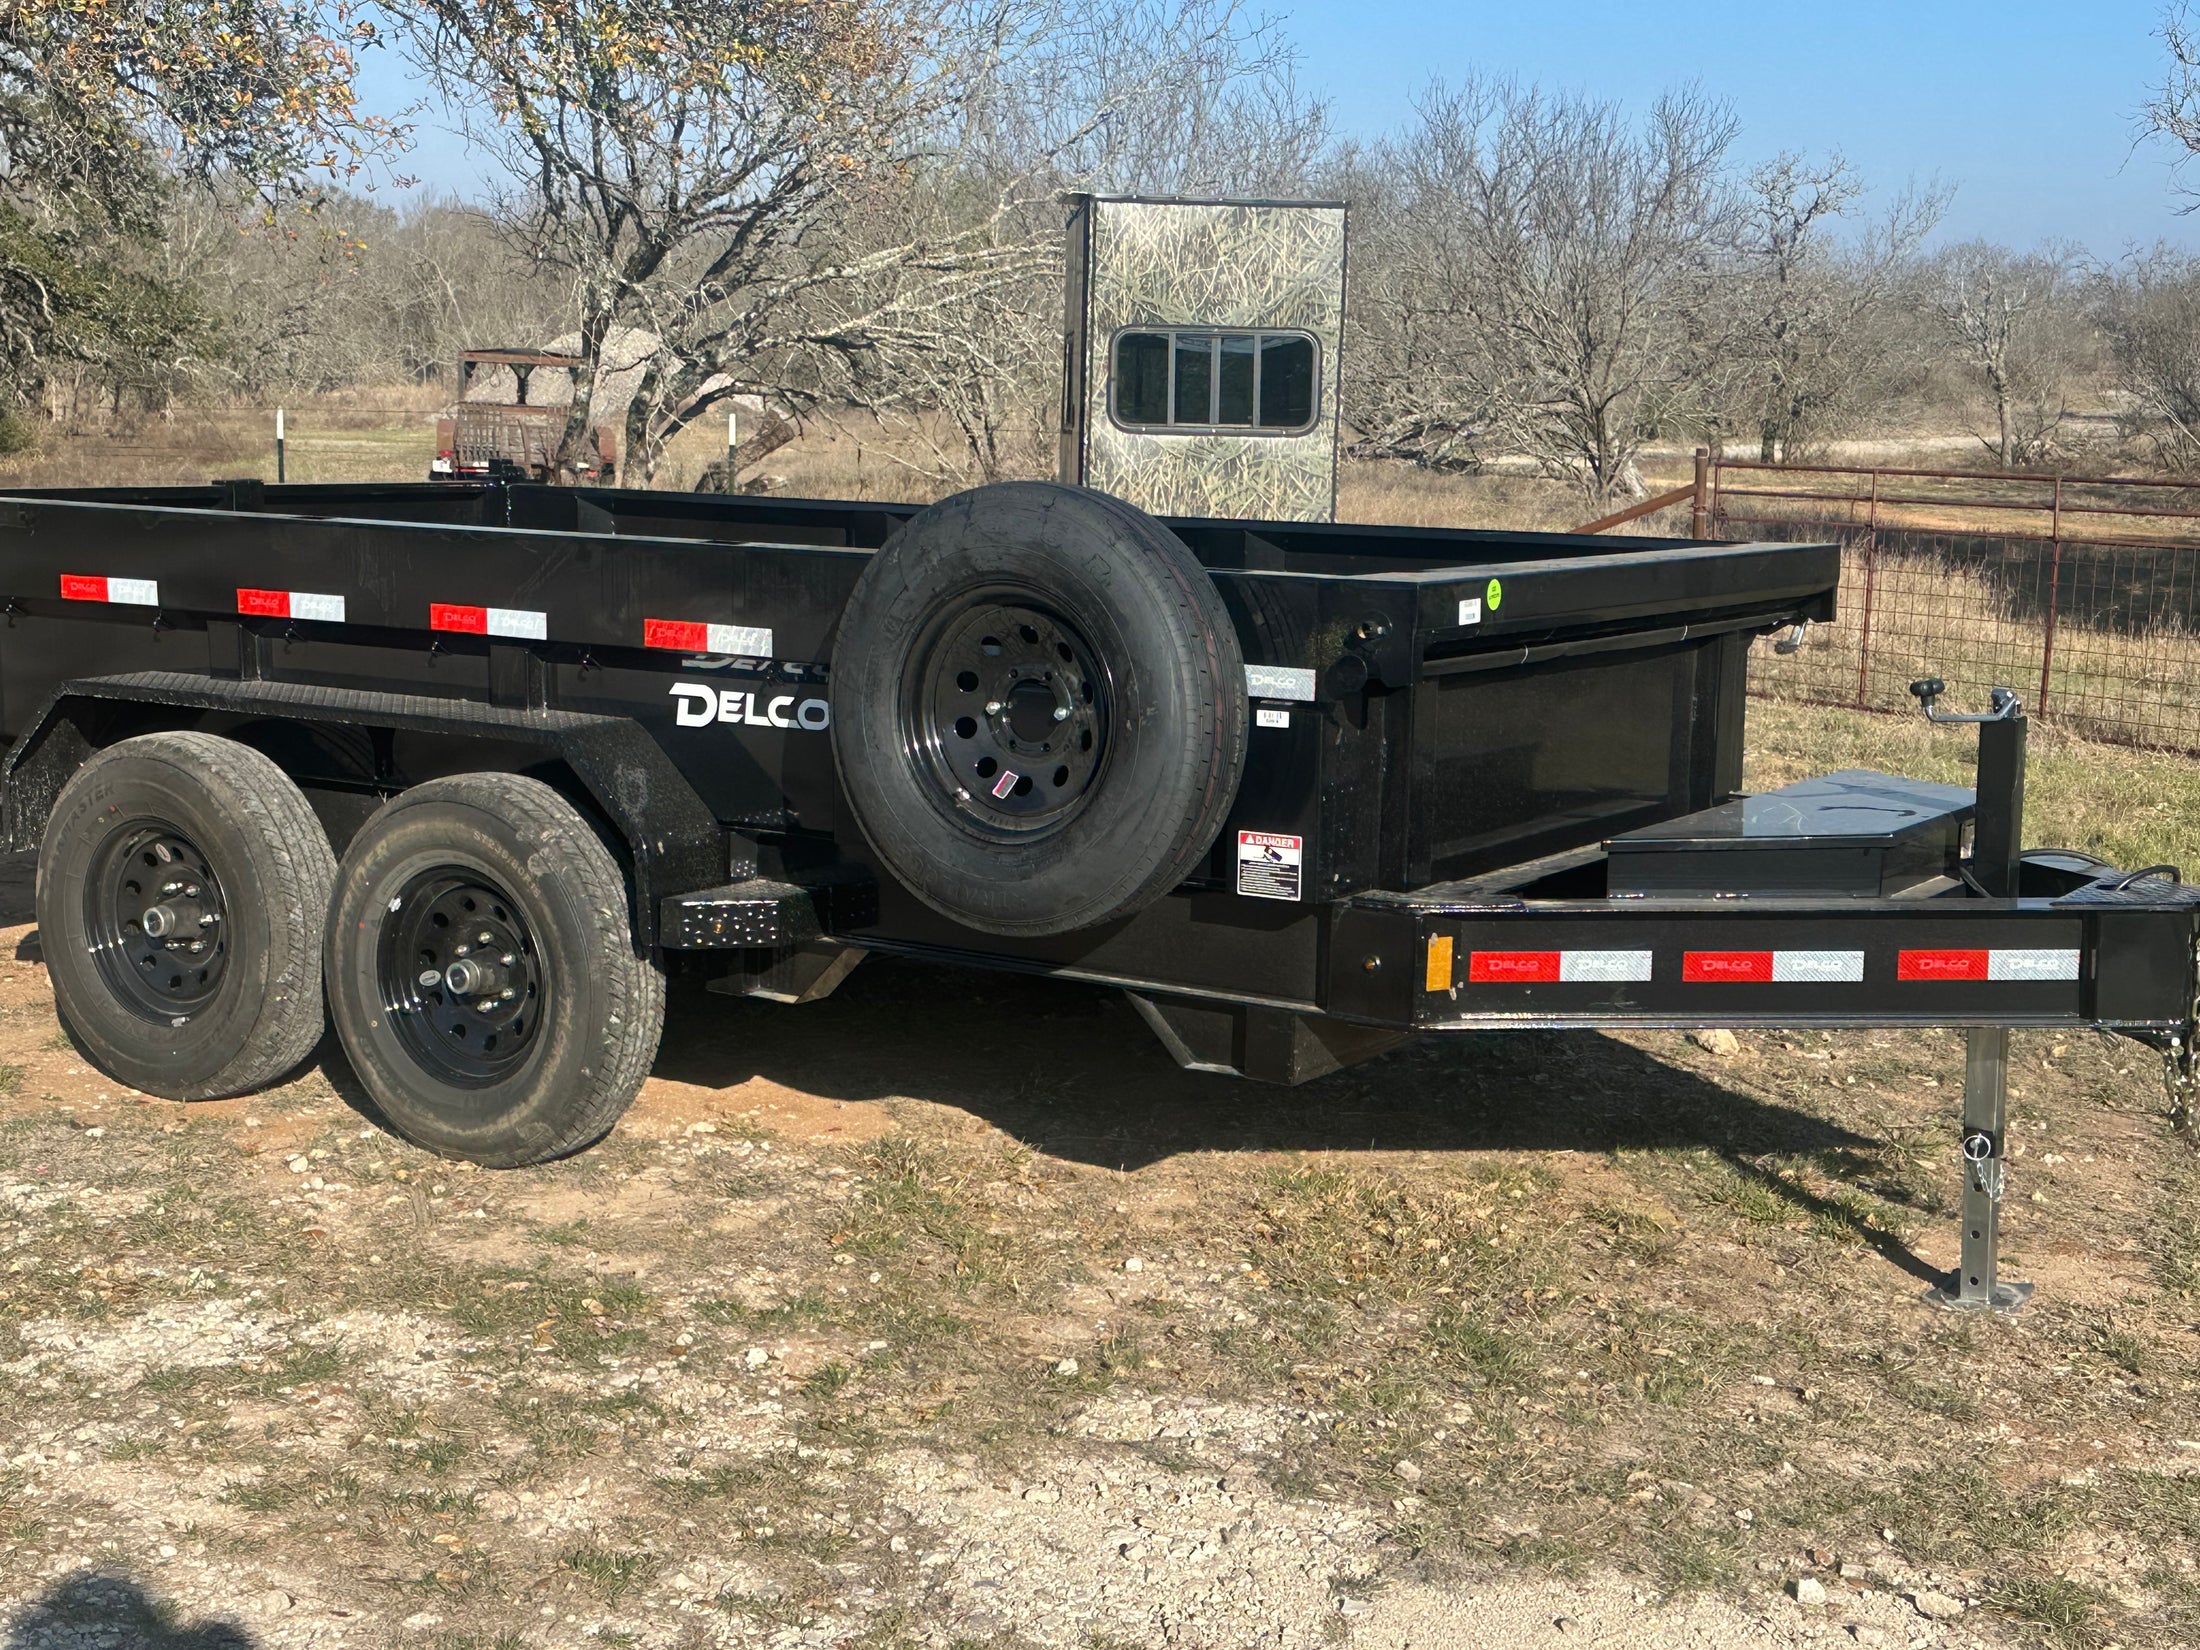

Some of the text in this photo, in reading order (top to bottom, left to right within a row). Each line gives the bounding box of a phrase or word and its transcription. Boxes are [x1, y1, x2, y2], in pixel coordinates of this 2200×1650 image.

[668, 682, 829, 730] DELCO
[1256, 835, 1294, 848] DANGER
[1487, 959, 1538, 971] DELCO
[1577, 959, 1628, 971] DELCO
[1701, 959, 1752, 971] DELCO
[1790, 959, 1842, 971] DELCO
[1918, 958, 1969, 970] DELCO
[2009, 958, 2060, 970] DELCO
